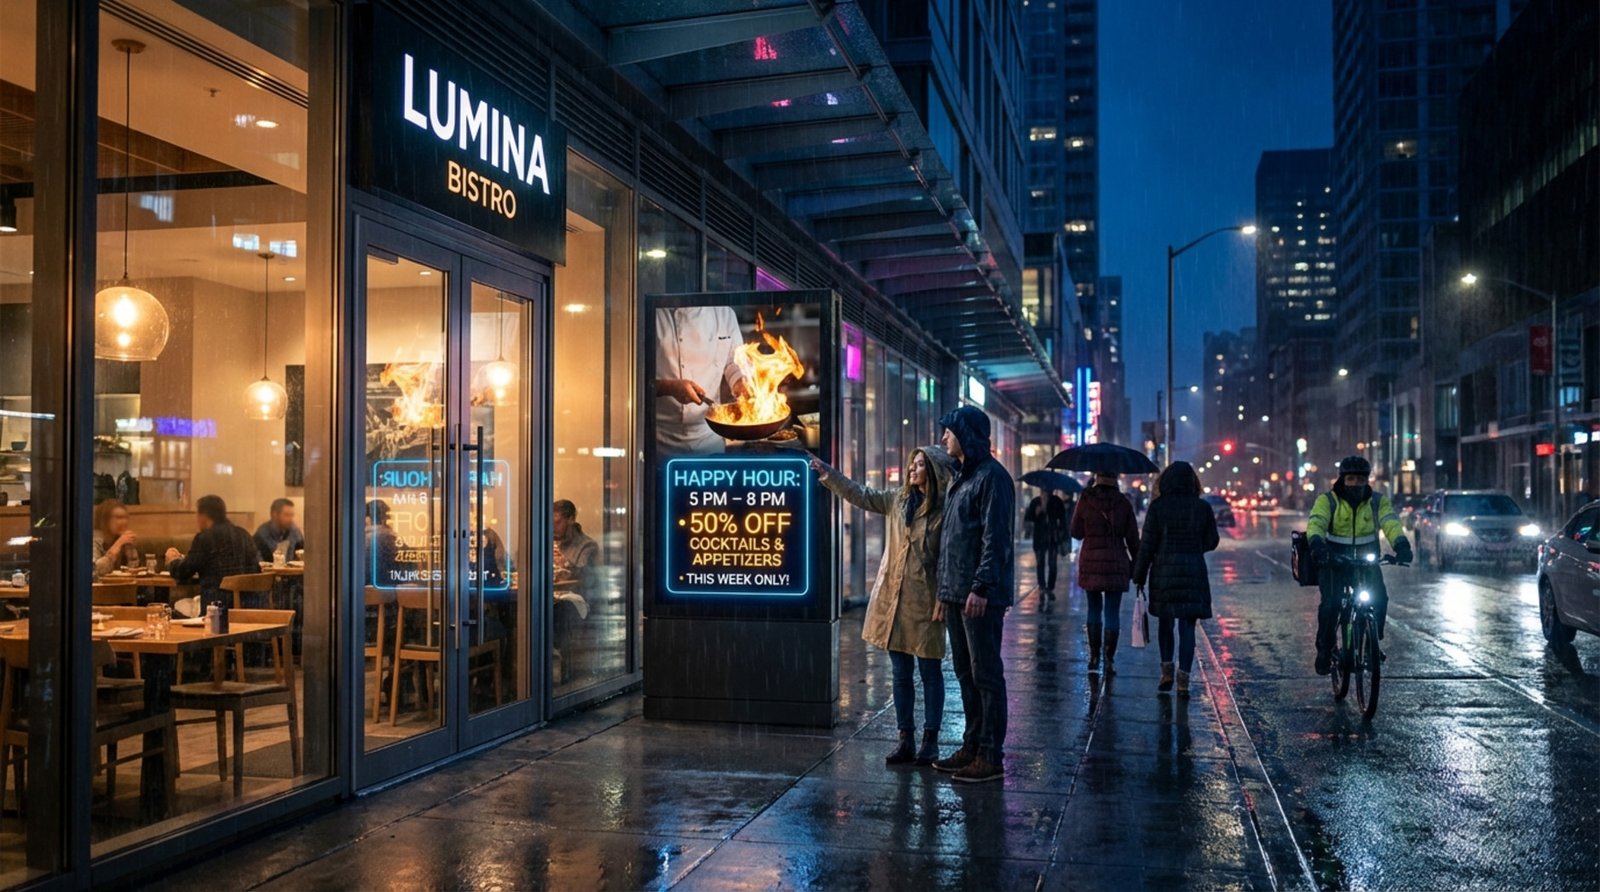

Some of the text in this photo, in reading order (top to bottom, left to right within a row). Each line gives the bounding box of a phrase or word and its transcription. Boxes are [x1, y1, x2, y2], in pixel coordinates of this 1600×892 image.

[404, 53, 550, 195] LUMINA
[448, 160, 517, 218] BISTRO
[674, 470, 801, 487] HAPPY HOUR:
[689, 492, 699, 506] 5
[703, 492, 727, 506] PM
[746, 492, 756, 506] 8
[760, 492, 786, 506] PM
[690, 512, 792, 534] 50% OFF
[689, 537, 785, 551] COCKTAILS &
[692, 553, 782, 567] APPETIZERS
[686, 572, 790, 586] THIS WEEK ONLY!
